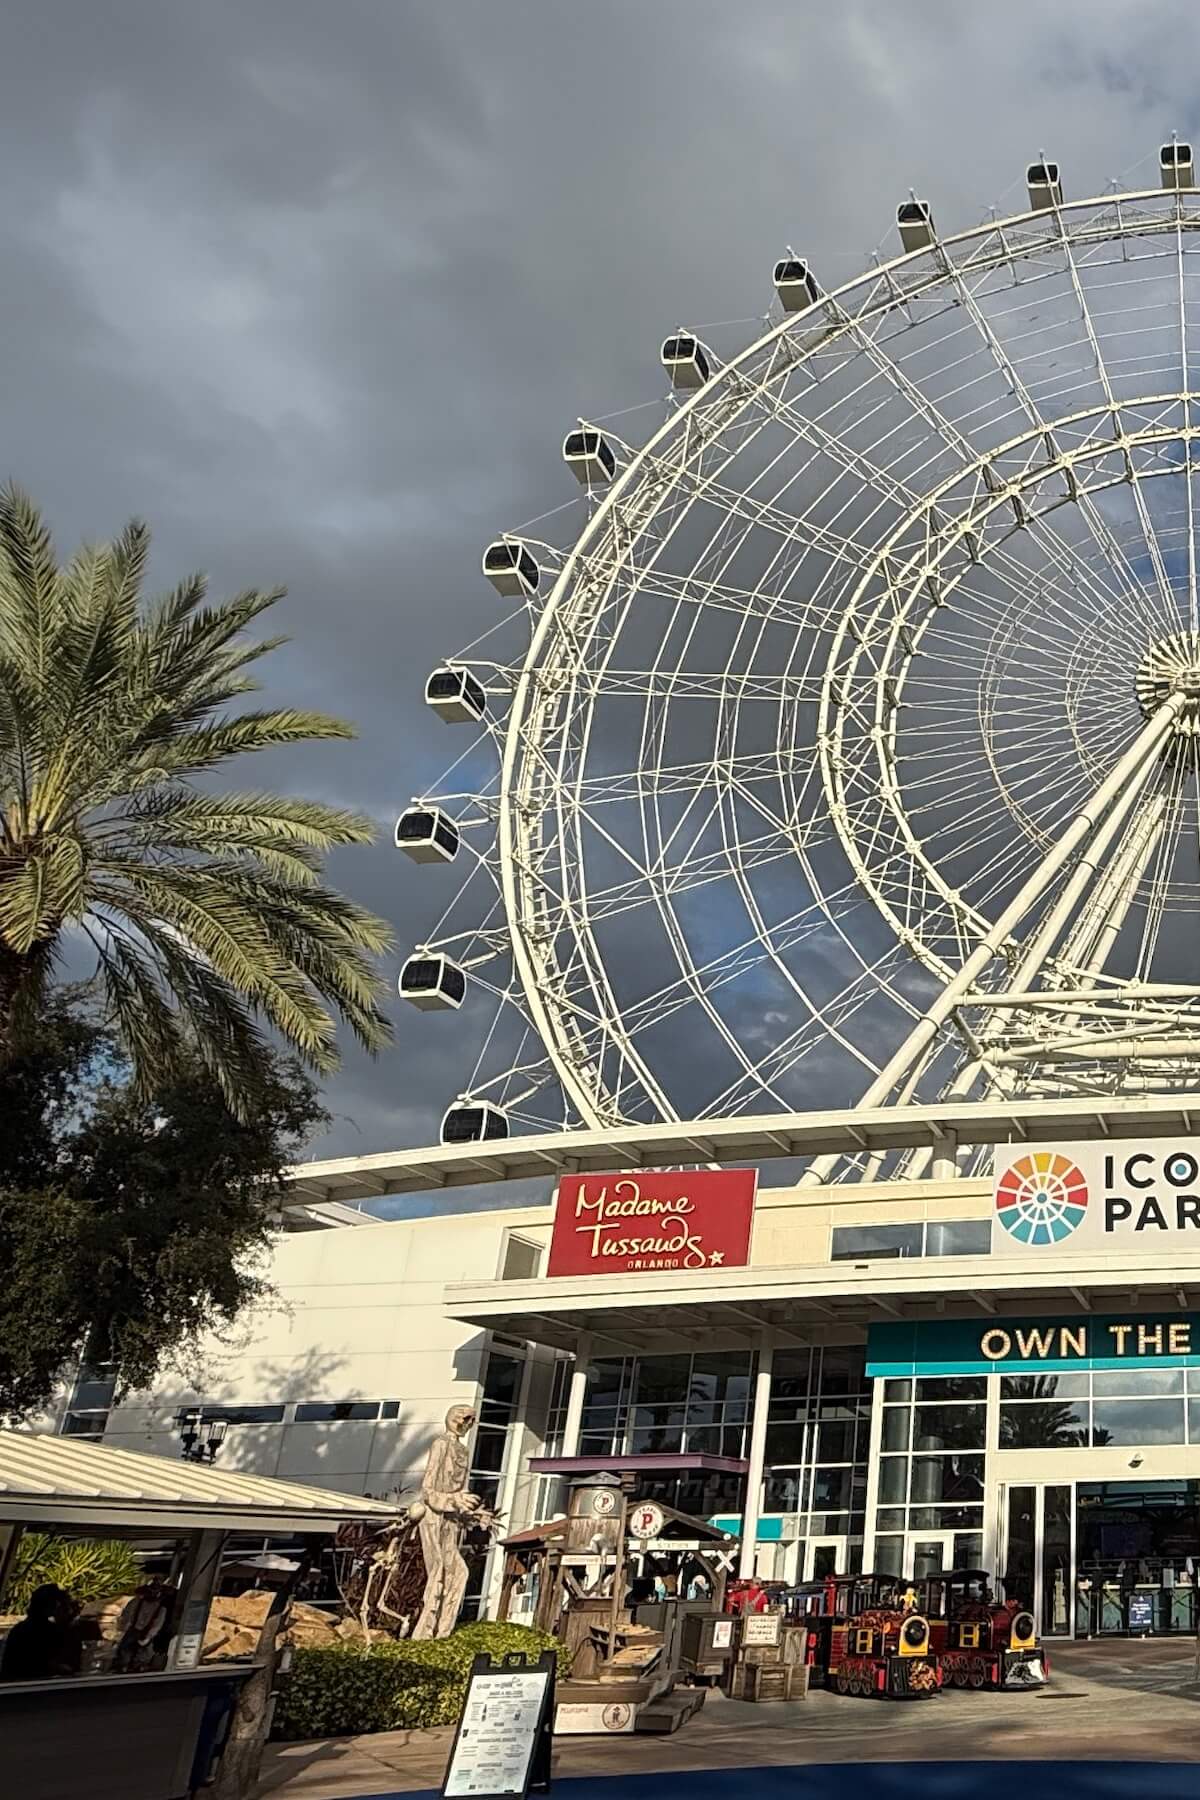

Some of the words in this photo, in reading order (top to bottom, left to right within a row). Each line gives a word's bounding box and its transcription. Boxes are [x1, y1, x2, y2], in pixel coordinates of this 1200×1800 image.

[575, 1180, 696, 1221] Madame
[575, 1216, 706, 1269] Tussauds
[627, 1259, 679, 1269] ORLANDO
[980, 1327, 1087, 1360] OWN
[1108, 1323, 1192, 1355] THE
[641, 1513, 653, 1530] P
